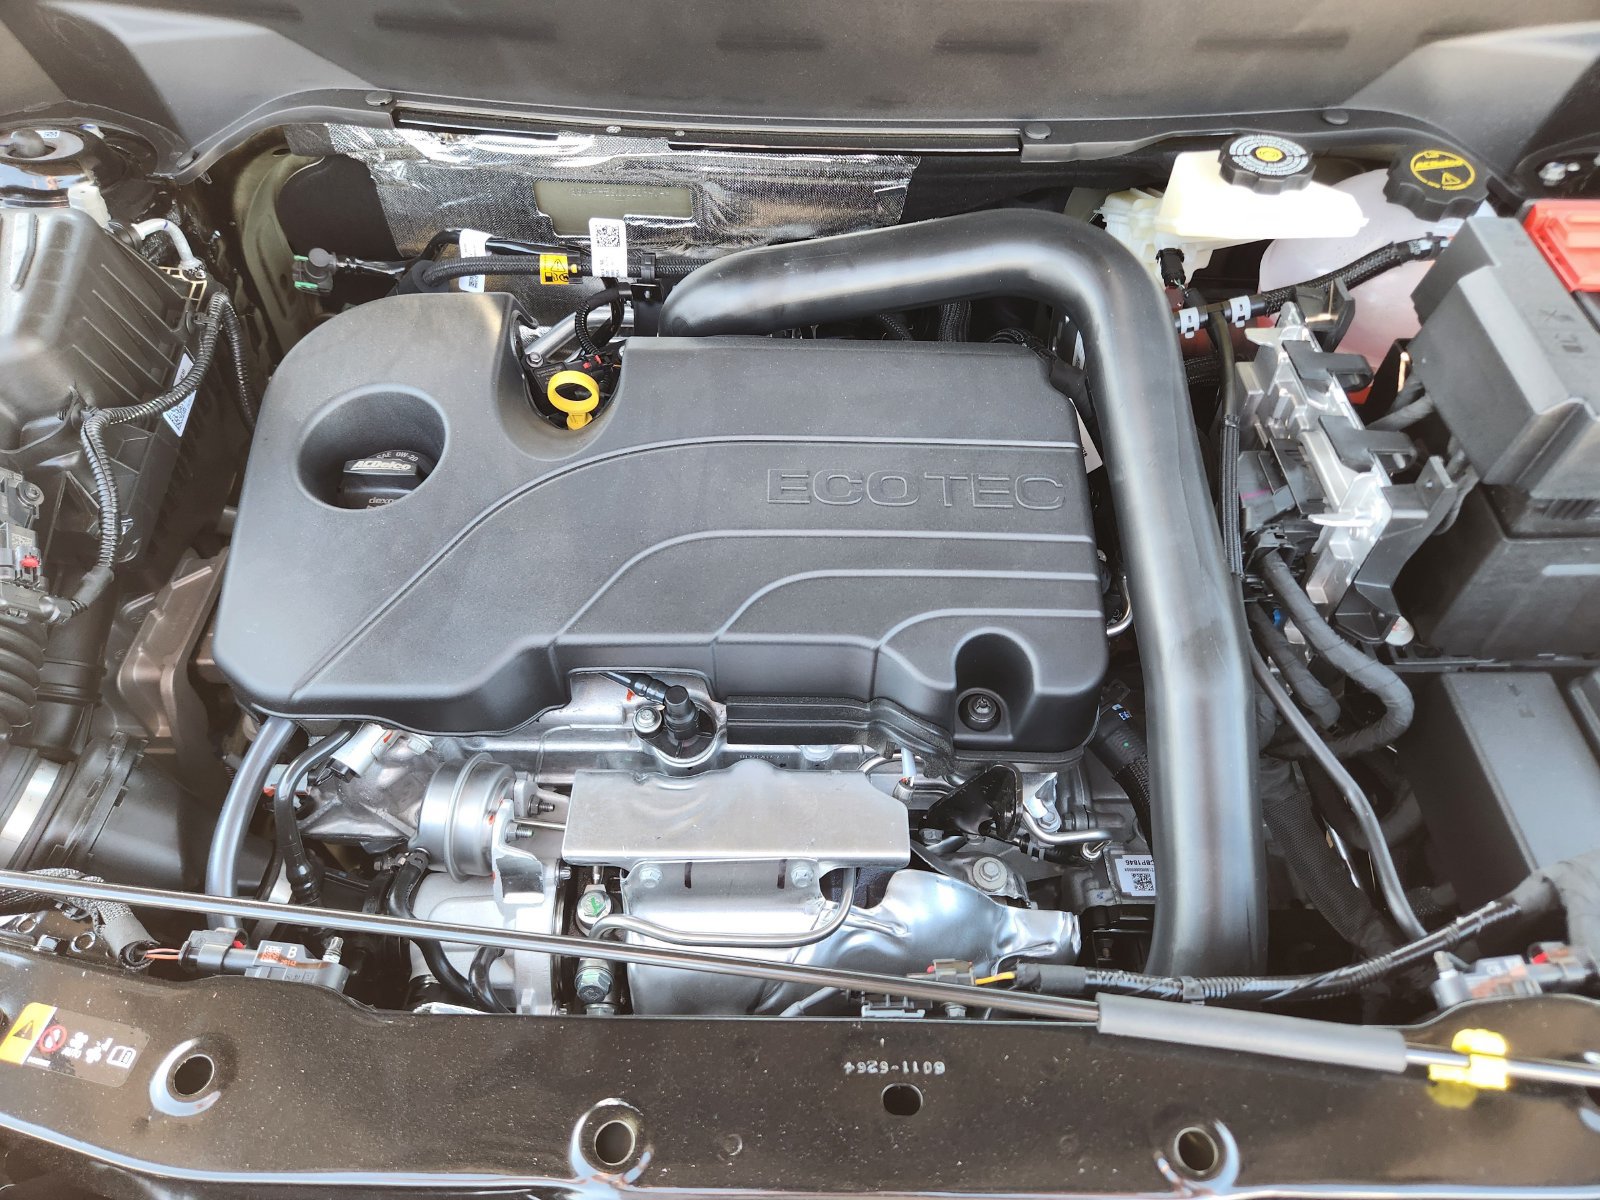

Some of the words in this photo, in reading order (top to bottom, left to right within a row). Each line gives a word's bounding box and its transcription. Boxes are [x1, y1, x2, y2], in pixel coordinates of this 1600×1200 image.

[349, 460, 412, 471] ACDelco
[767, 468, 1066, 510] ECOTEC
[287, 946, 298, 959] B
